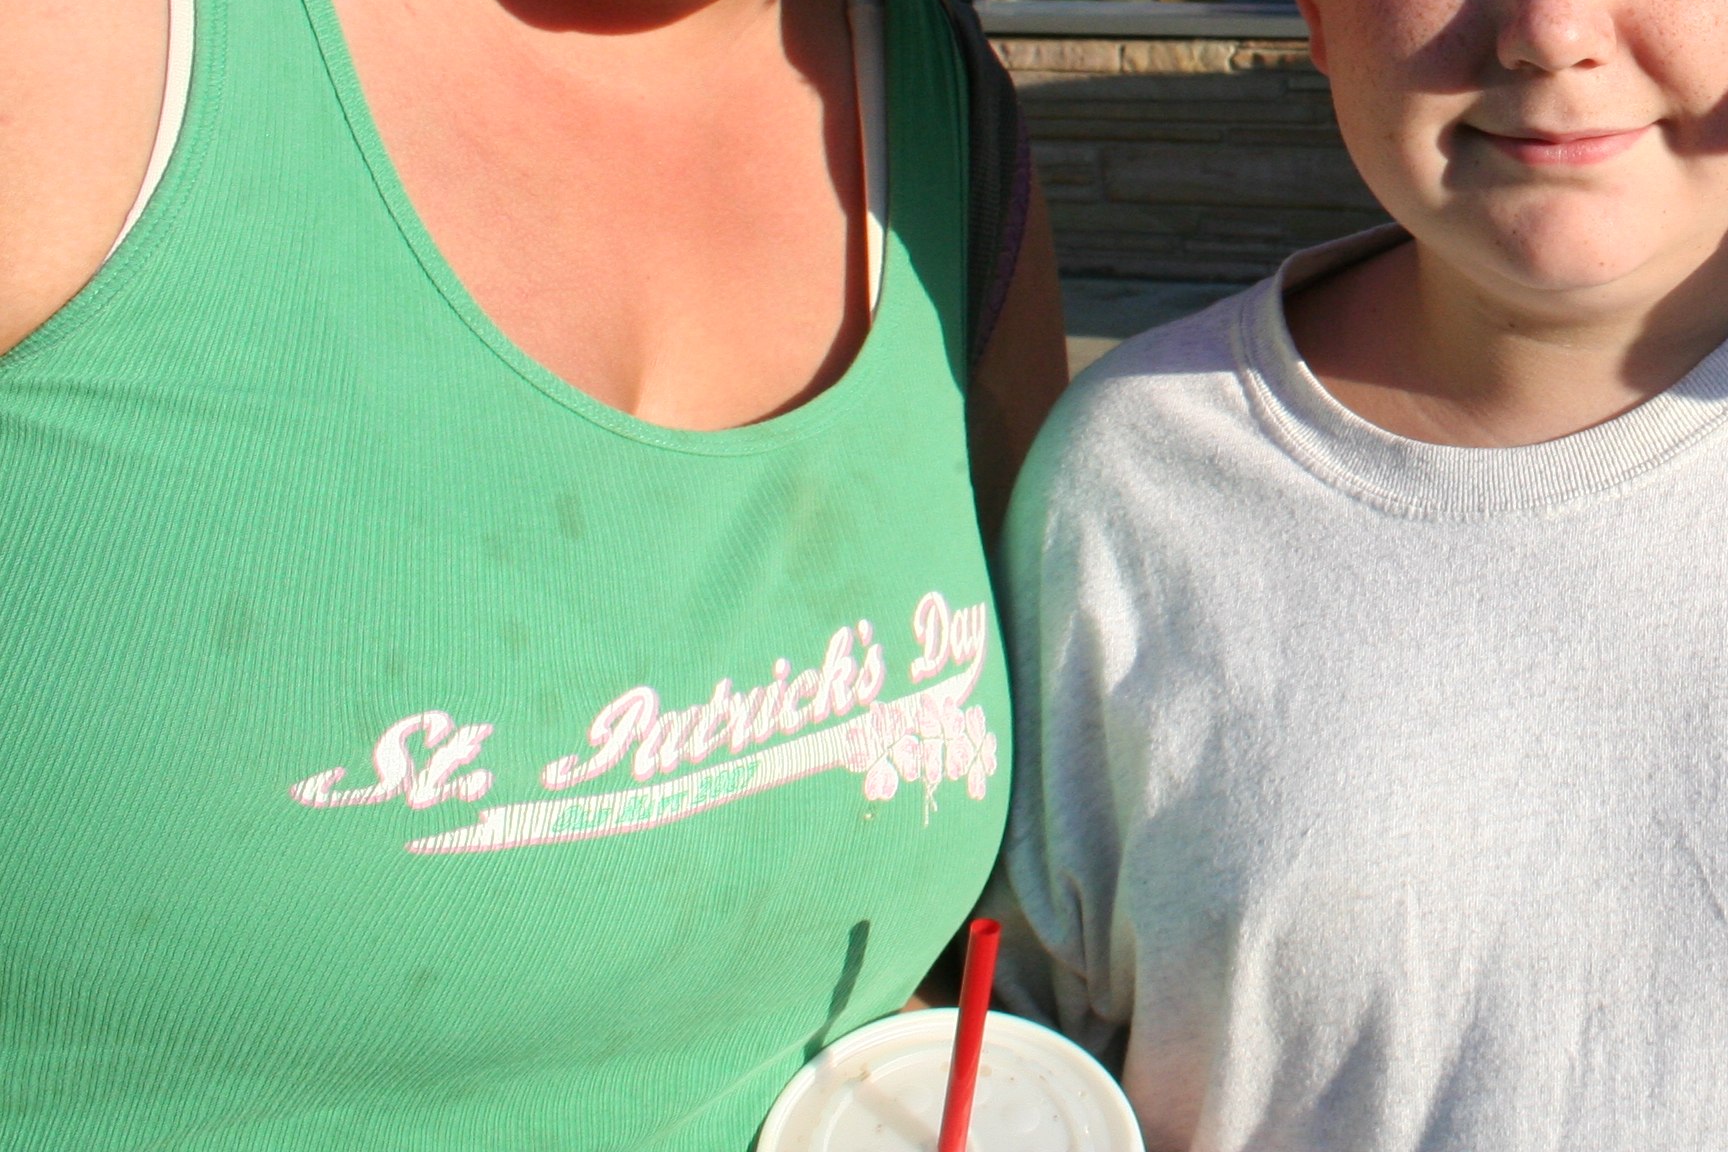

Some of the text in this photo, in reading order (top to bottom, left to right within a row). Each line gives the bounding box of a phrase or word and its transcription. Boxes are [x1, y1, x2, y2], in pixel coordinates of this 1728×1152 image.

[290, 590, 988, 809] St. Patrick's Day
